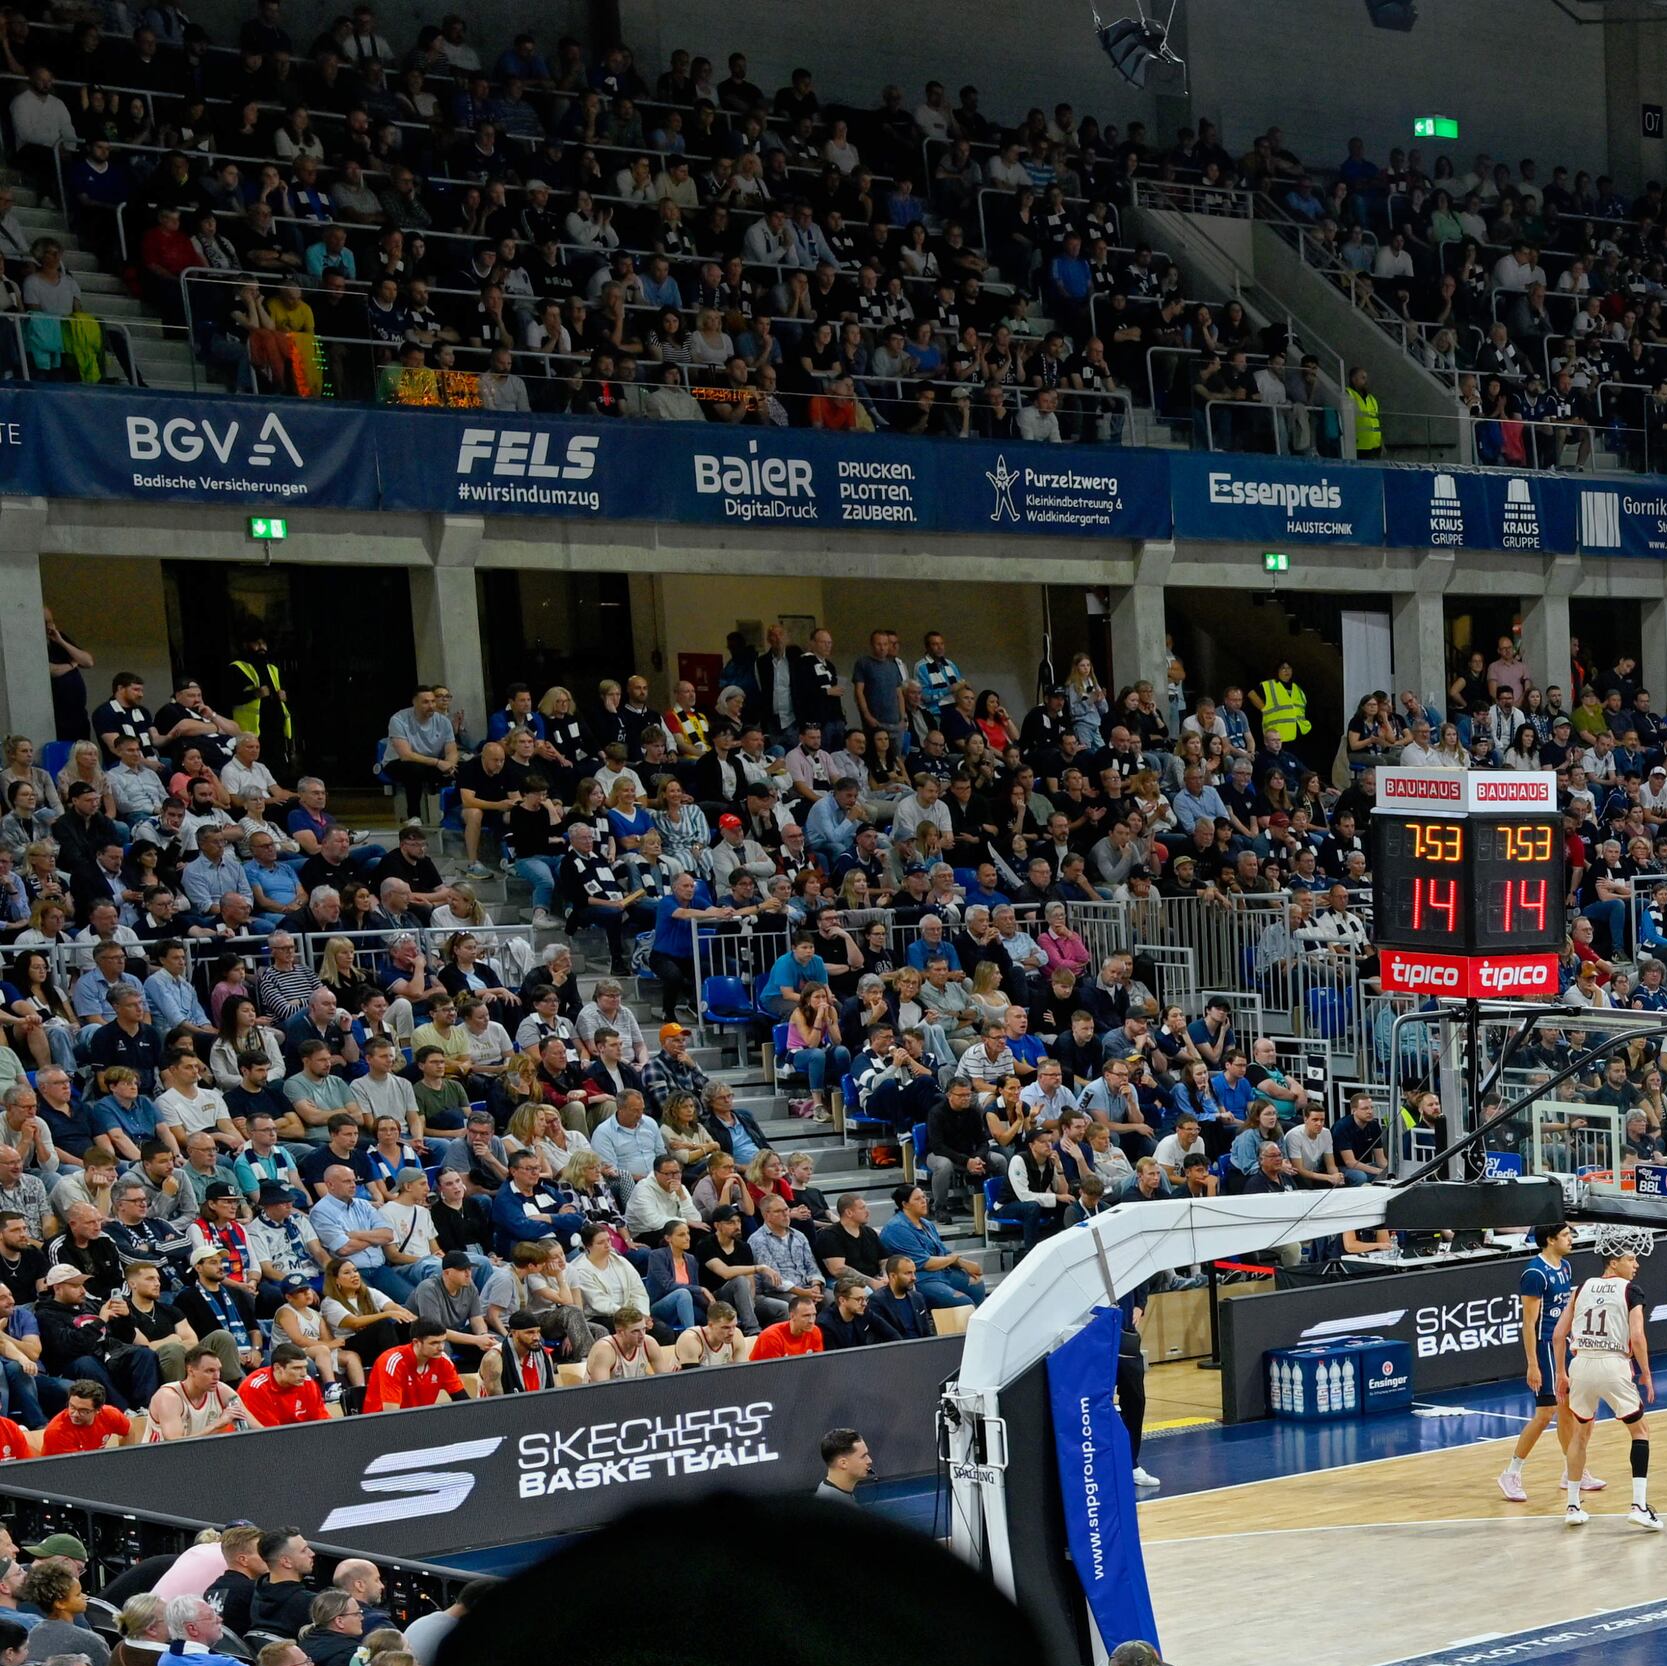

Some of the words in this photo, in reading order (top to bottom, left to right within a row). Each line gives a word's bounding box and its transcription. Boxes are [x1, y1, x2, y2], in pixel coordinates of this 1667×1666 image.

[127, 415, 239, 463] BGV
[456, 427, 599, 481] FELS
[133, 473, 196, 492] Badische
[199, 475, 308, 496] Versicherungen
[1024, 467, 1118, 496] Purzelzwerg
[458, 483, 600, 511] #wirsindumzug
[1026, 494, 1114, 513] Kleinkindbetreuung
[1116, 498, 1123, 510] &
[1208, 471, 1342, 517] Essenpreis
[724, 499, 819, 520] DigitalDruck
[1622, 496, 1667, 517] Gornik
[1026, 510, 1110, 527] Waldkindergarten
[1286, 520, 1353, 536] HAUSTECHNIK
[1430, 517, 1464, 532] KRAUS
[1503, 521, 1539, 535] KRAUS
[1431, 532, 1464, 547] GRUPPE
[1503, 535, 1540, 549] GRUPPE
[1385, 778, 1461, 800] BAUHAUS
[1477, 782, 1549, 801] BAUHAUS
[1412, 877, 1456, 932] 14
[1503, 879, 1547, 932] 14
[1391, 956, 1459, 988] tipico
[1479, 960, 1548, 991] tipico
[1640, 1181, 1661, 1194] BBL
[1582, 1308, 1609, 1337] 11
[1368, 1375, 1408, 1390] Ensinger
[518, 1402, 773, 1471] SKECHERS
[518, 1443, 779, 1499] BASKETBALL
[1078, 1397, 1106, 1581] www.snpgroup.com
